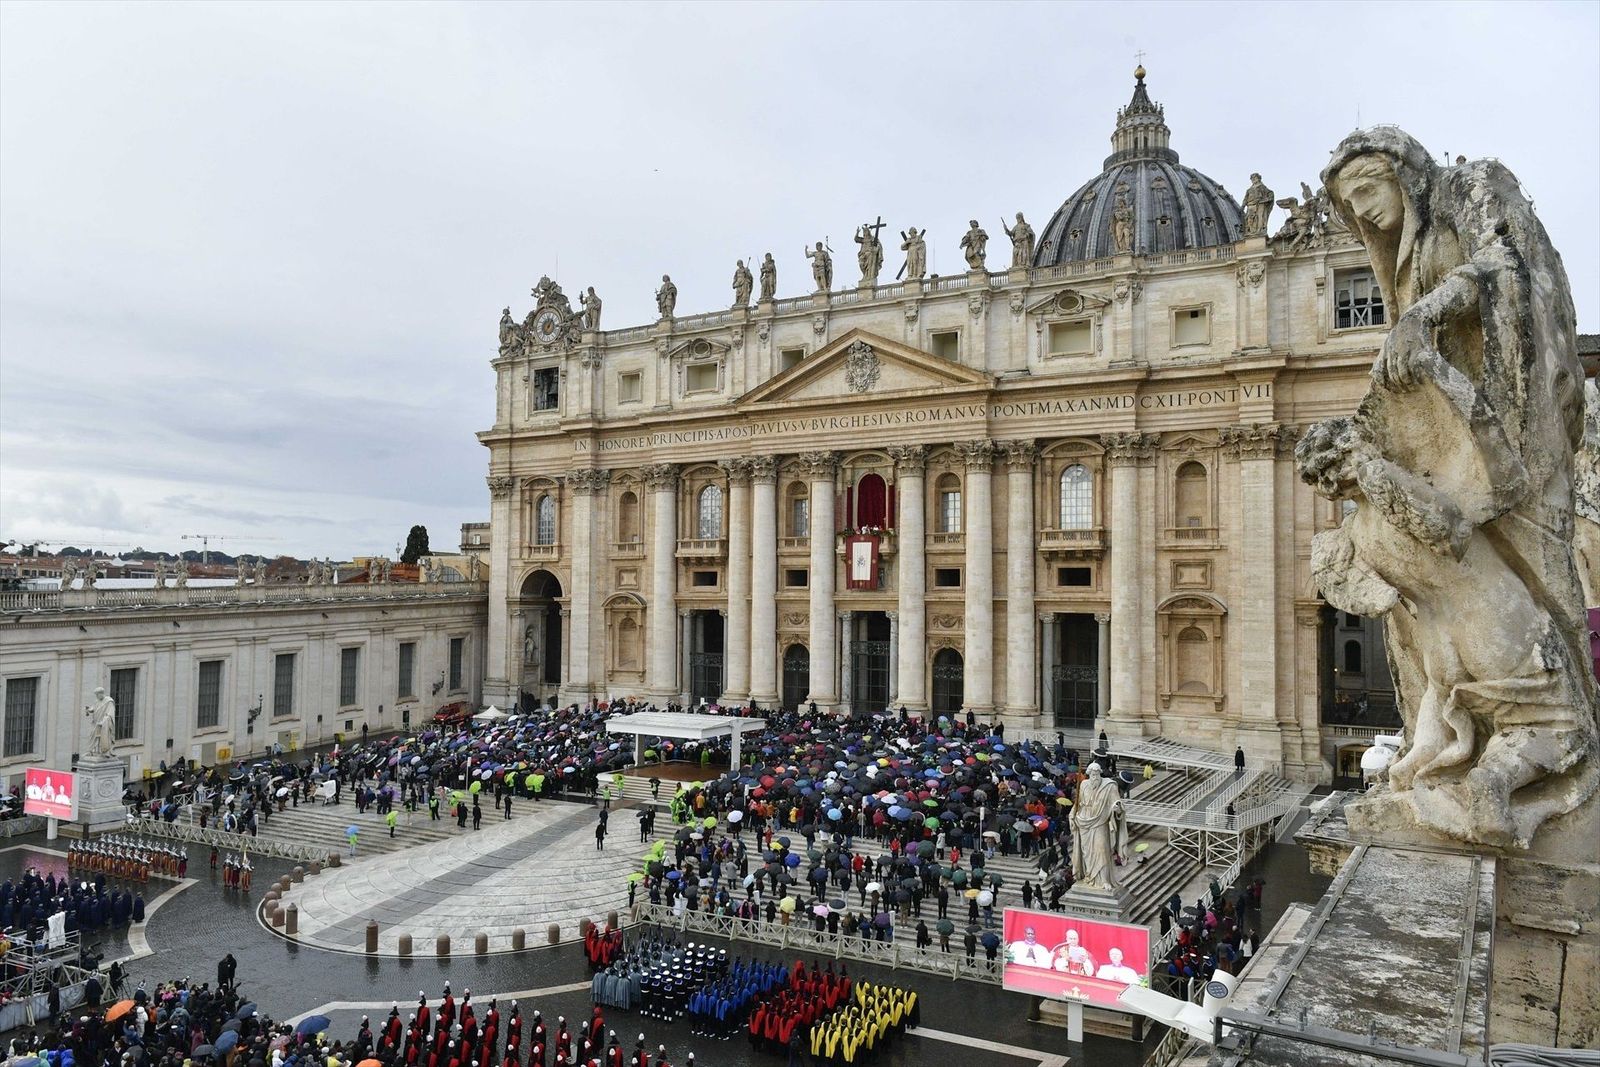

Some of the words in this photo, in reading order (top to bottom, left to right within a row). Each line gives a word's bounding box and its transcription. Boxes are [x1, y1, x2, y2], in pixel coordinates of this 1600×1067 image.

[574, 440, 587, 451] IN
[1188, 388, 1239, 406] PONT
[1242, 384, 1271, 399] VII
